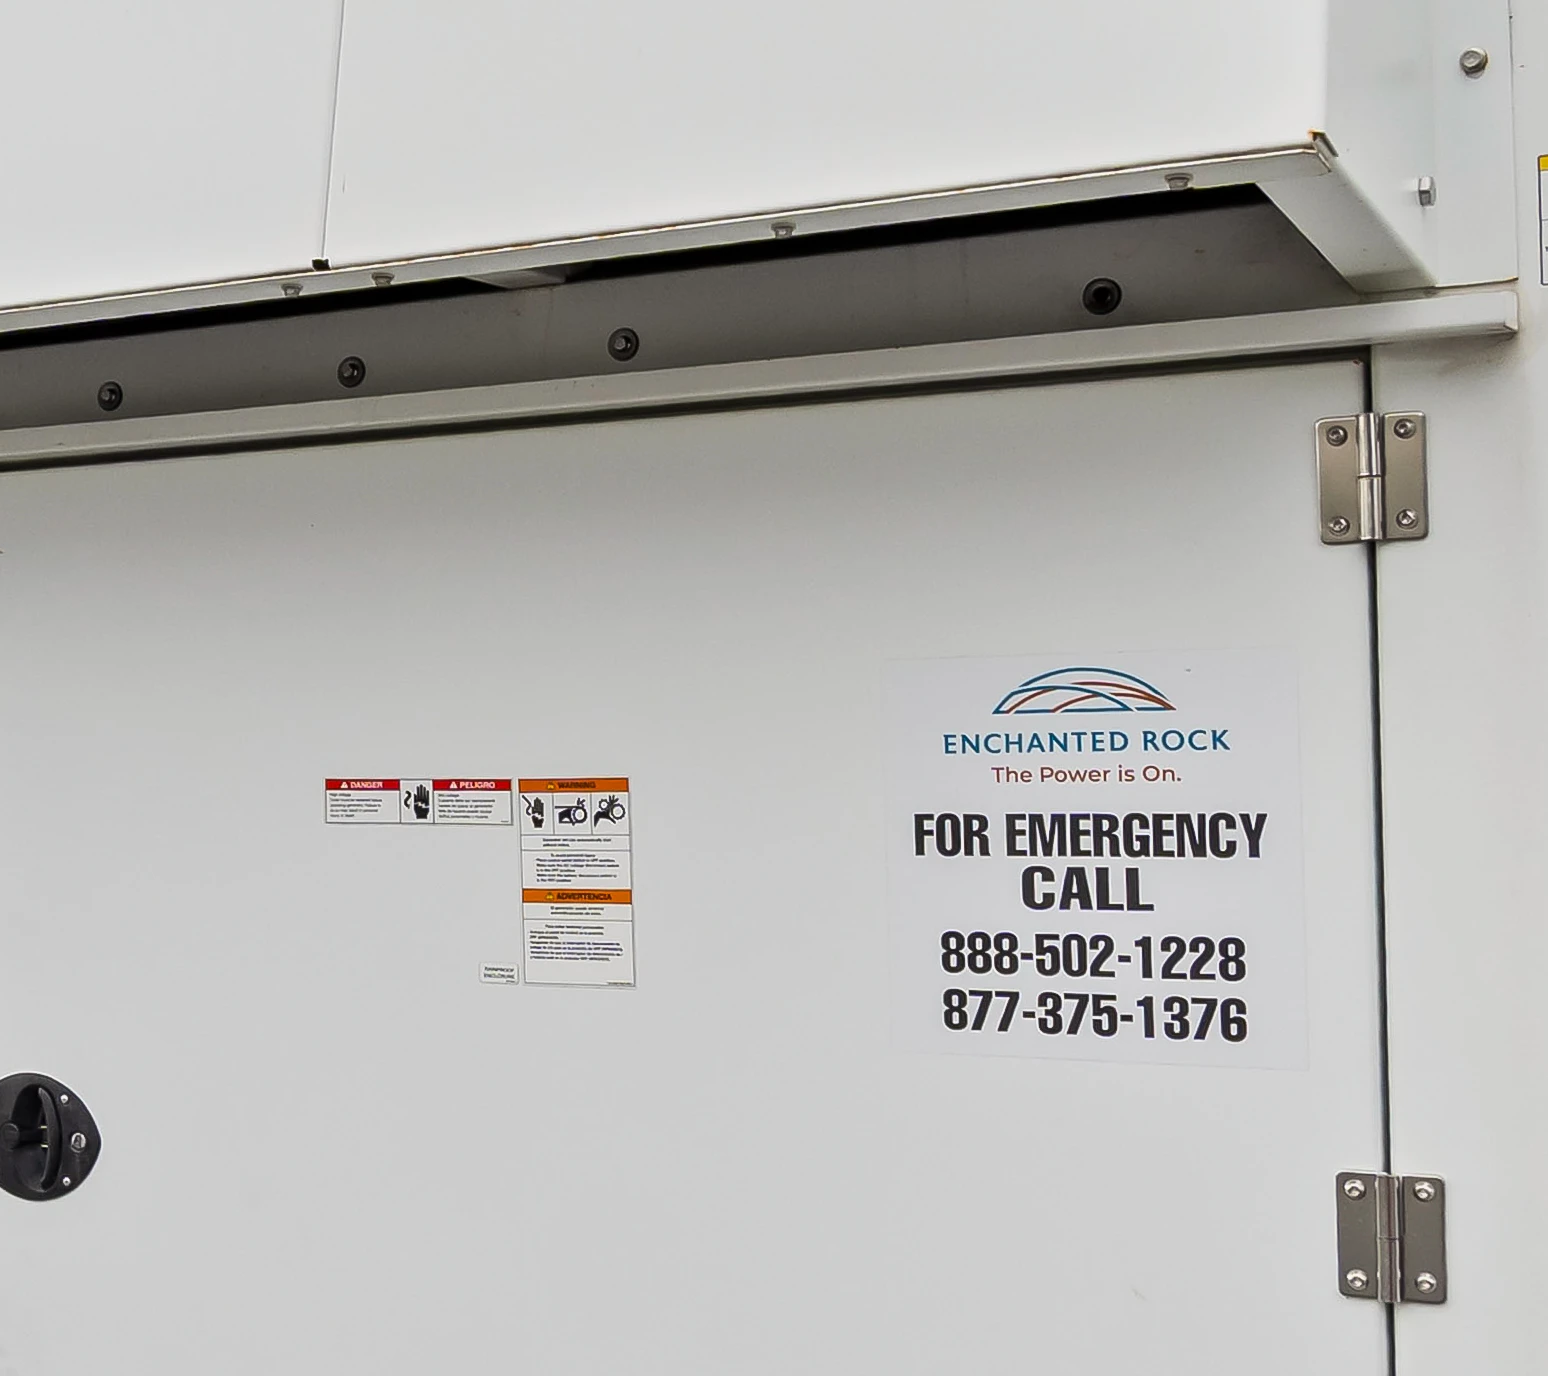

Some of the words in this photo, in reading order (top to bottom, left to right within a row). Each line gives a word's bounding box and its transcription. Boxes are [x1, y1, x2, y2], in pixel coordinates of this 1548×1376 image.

[942, 730, 1129, 755] ENCHANTED
[1141, 728, 1231, 752] ROCK
[350, 781, 383, 789] DANGER
[460, 781, 496, 789] PELIGRO
[990, 765, 1033, 784] The
[1040, 765, 1112, 783] Power
[1117, 763, 1136, 783] is
[1142, 764, 1182, 783] On.
[913, 812, 992, 858] FOR
[1004, 811, 1268, 859] EMERGENCY
[556, 892, 612, 901] ADVERTENCIA
[1021, 865, 1155, 912] CALL
[940, 930, 1247, 983] 888-502-1228
[942, 988, 1248, 1043] 877-375-1376
